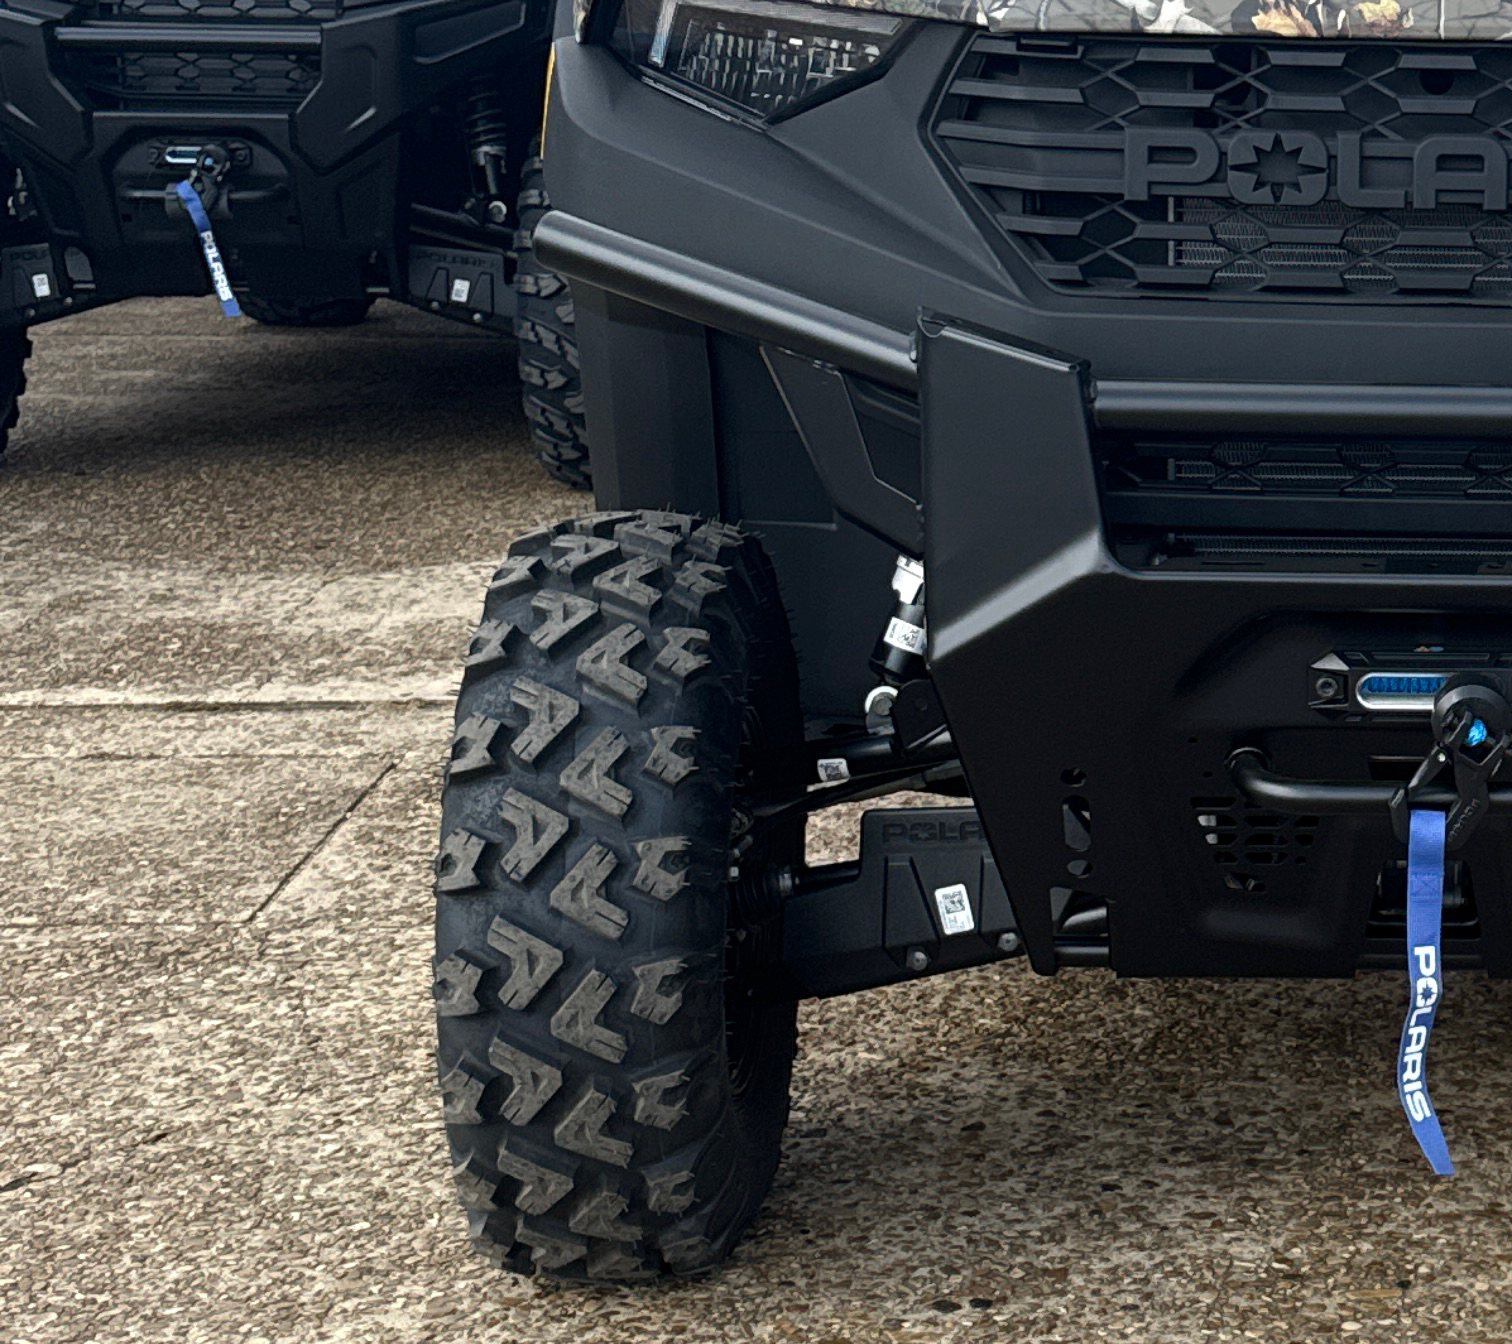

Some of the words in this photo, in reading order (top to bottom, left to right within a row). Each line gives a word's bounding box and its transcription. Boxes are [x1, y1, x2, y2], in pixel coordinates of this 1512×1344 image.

[201, 231, 233, 301] POLARIS
[882, 820, 985, 844] POLA
[1402, 945, 1436, 1123] POLARIS
